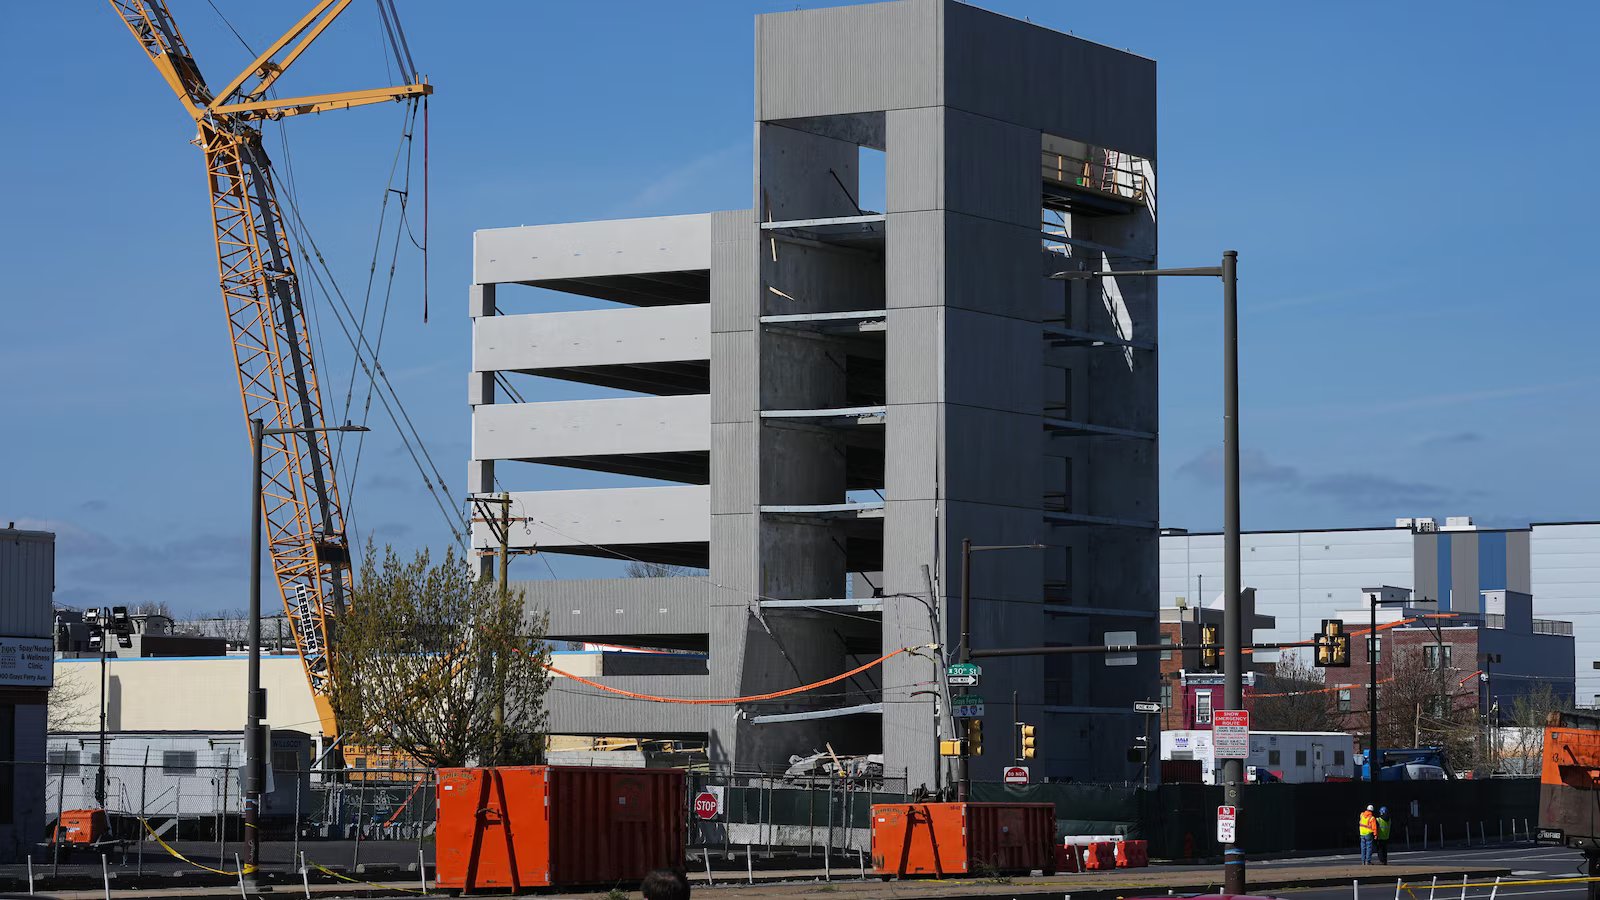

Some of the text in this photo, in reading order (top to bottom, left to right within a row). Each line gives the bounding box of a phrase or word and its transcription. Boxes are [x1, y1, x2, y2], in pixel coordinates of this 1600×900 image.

[296, 585, 317, 651] LIEBHERR
[19, 644, 53, 653] Spay/Neuter
[28, 662, 43, 670] Clinic
[272, 740, 302, 748] WILLSCOT
[696, 800, 717, 812] STOP
